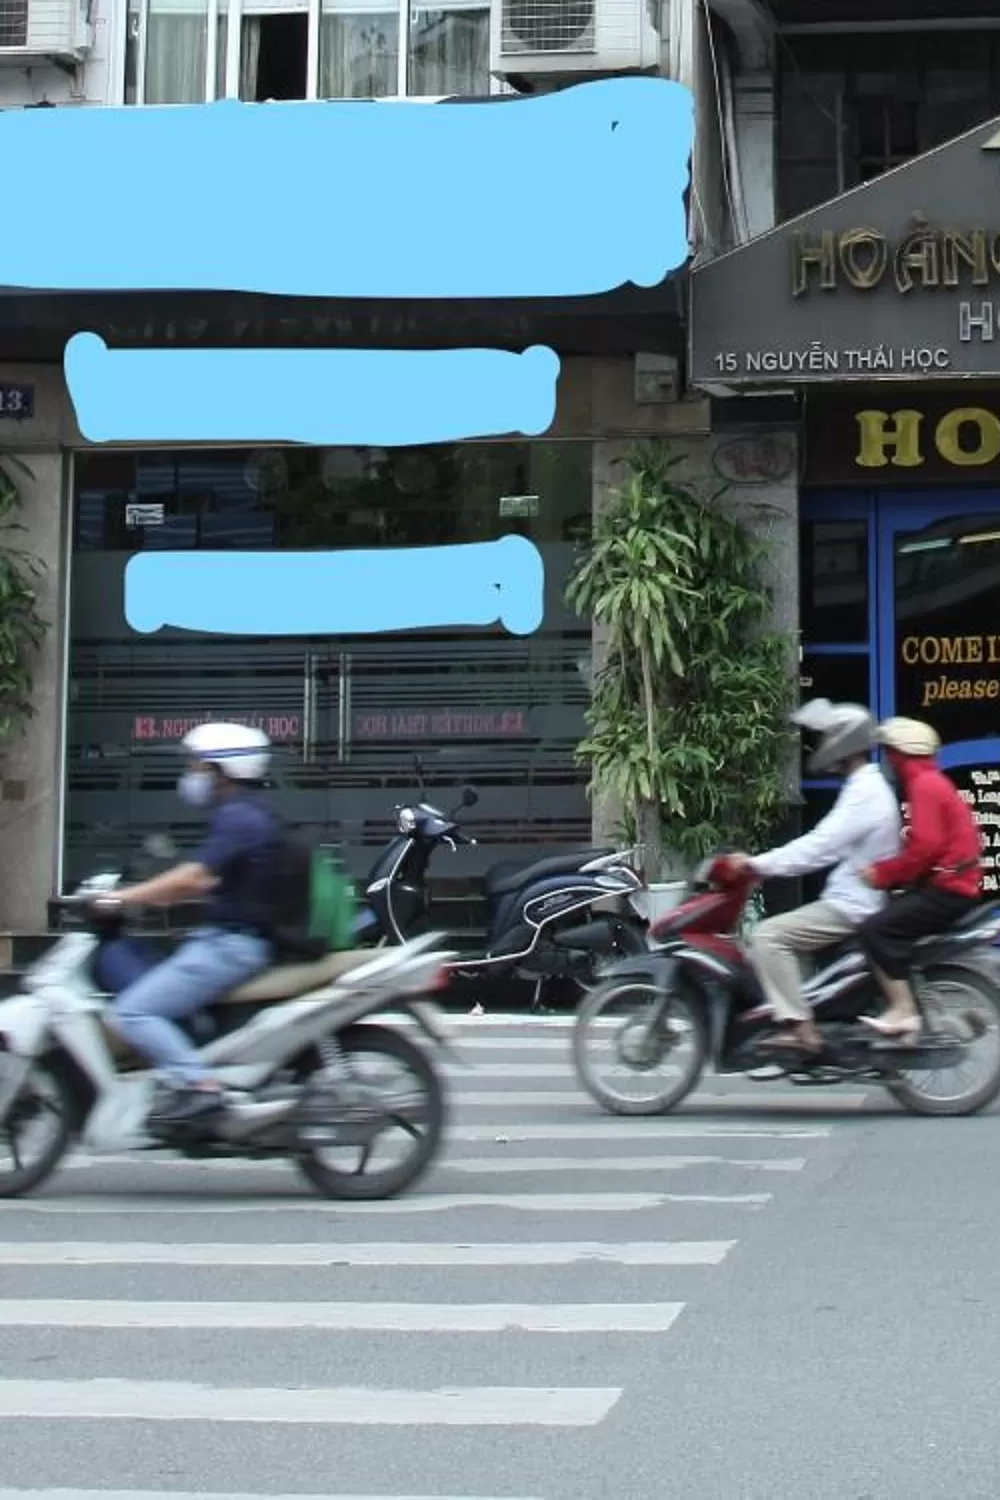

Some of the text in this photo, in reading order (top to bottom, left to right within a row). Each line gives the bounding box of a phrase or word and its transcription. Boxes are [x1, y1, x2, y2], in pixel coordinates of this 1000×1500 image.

[714, 340, 950, 373] 15 NGUYỄN THÁI HỌC
[901, 635, 984, 665] COME
